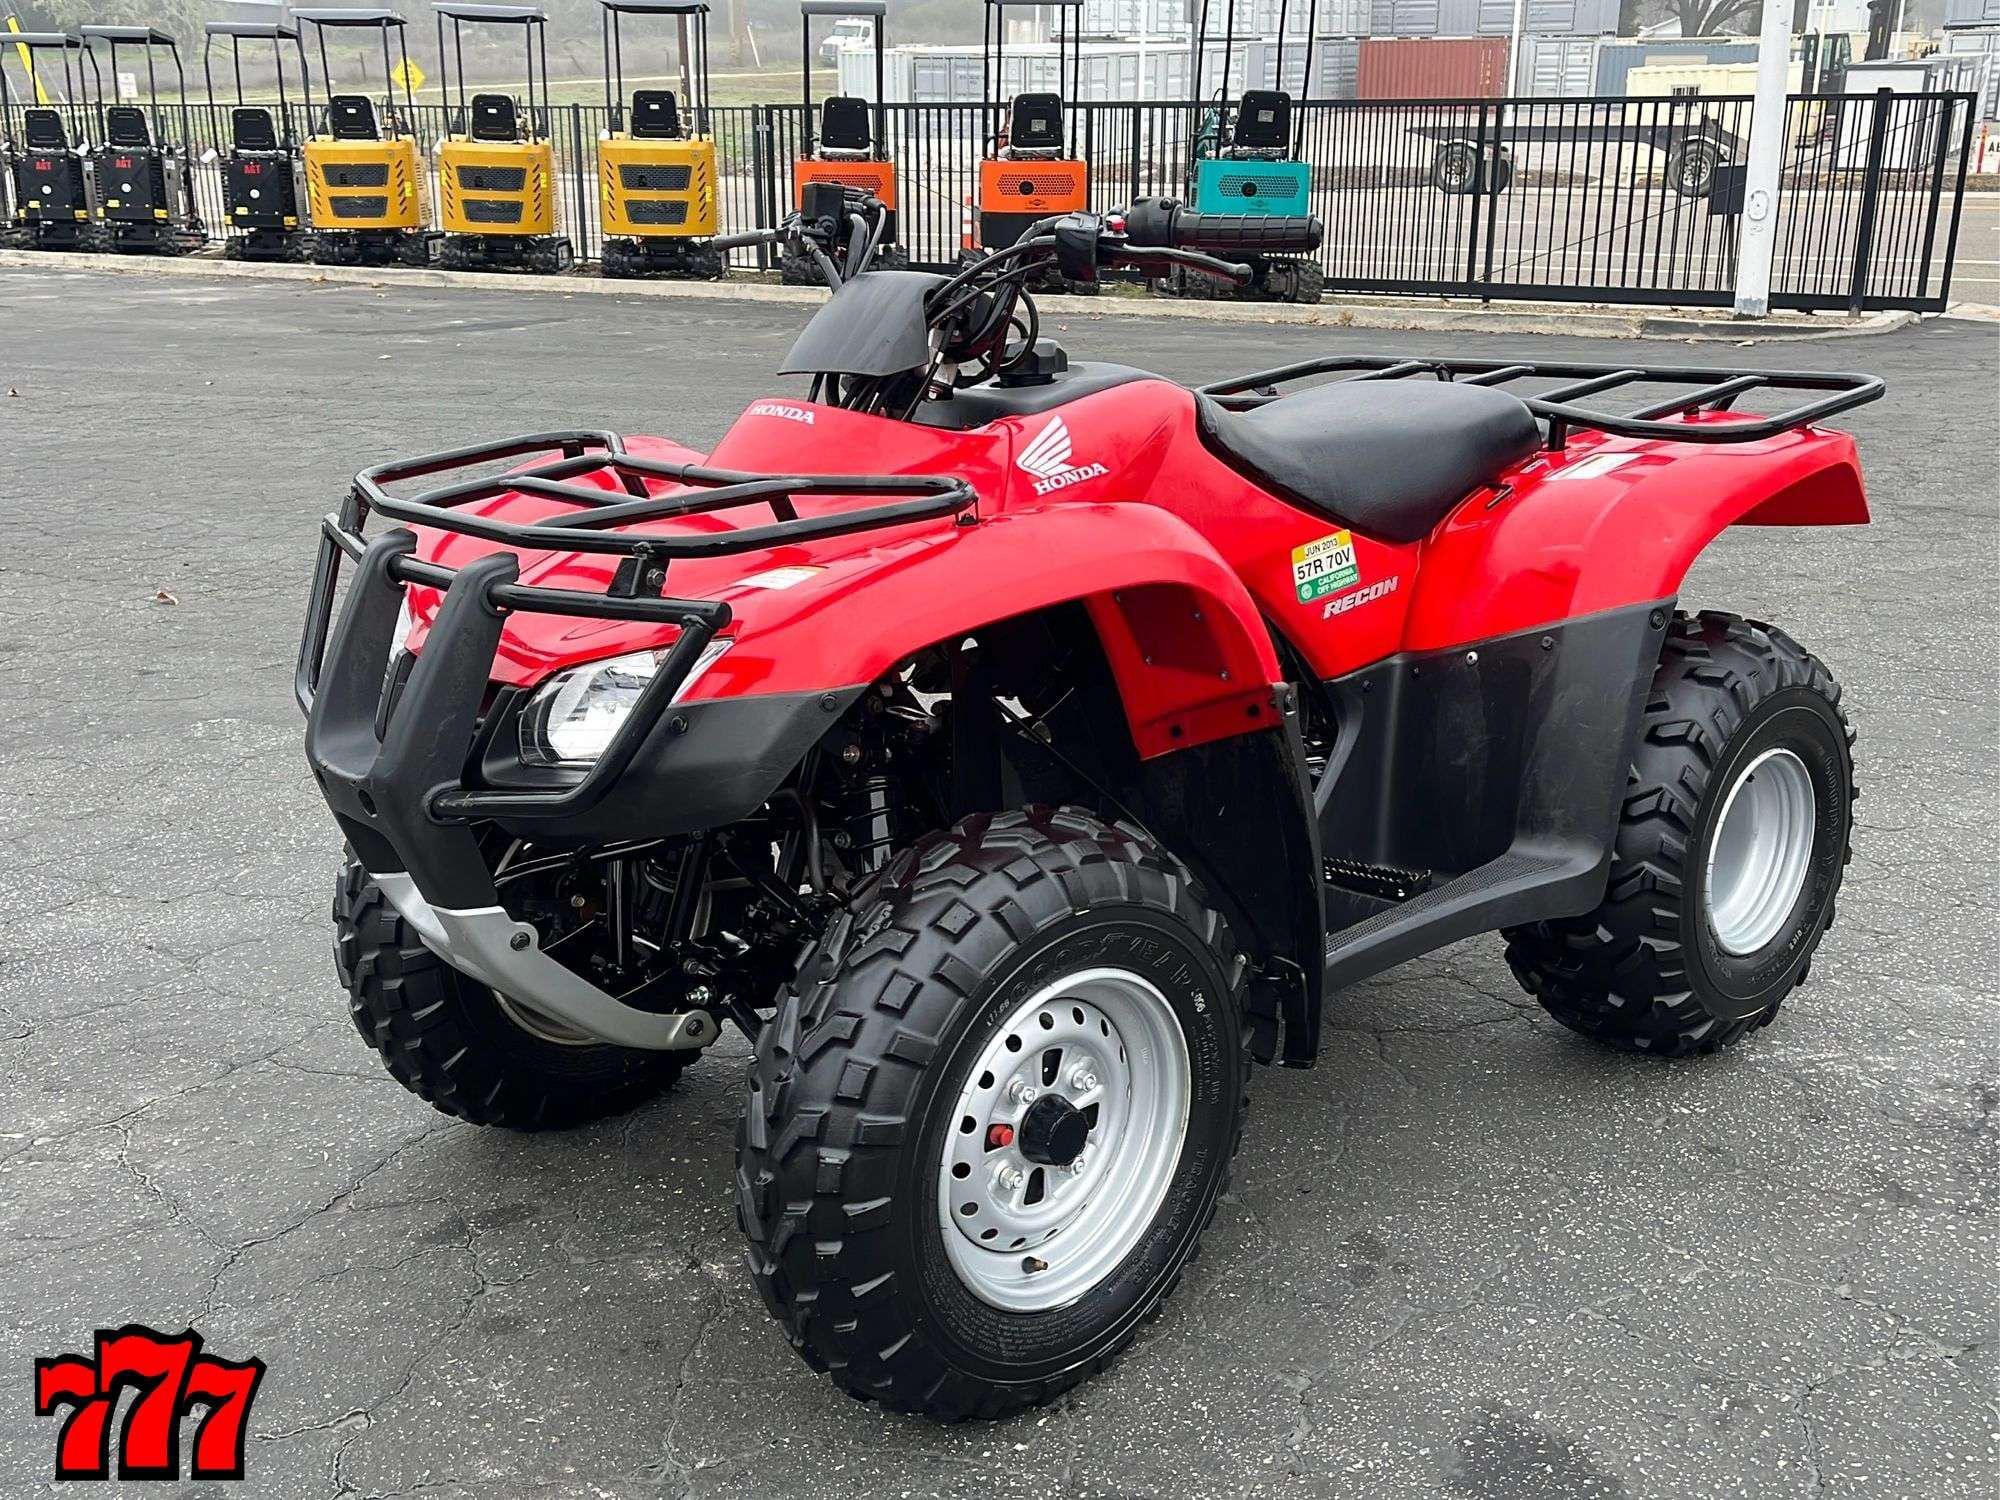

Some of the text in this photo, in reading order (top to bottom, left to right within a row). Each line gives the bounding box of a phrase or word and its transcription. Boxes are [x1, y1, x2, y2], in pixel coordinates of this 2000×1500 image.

[749, 404, 815, 425] HONDA
[1032, 462, 1110, 496] HONDA
[1305, 538, 1338, 557] JUN 2013
[1297, 547, 1350, 580] 57R 70V
[1318, 567, 1355, 585] CALIFORNIA
[1317, 585, 1330, 594] OFF
[1322, 575, 1399, 620] RECON
